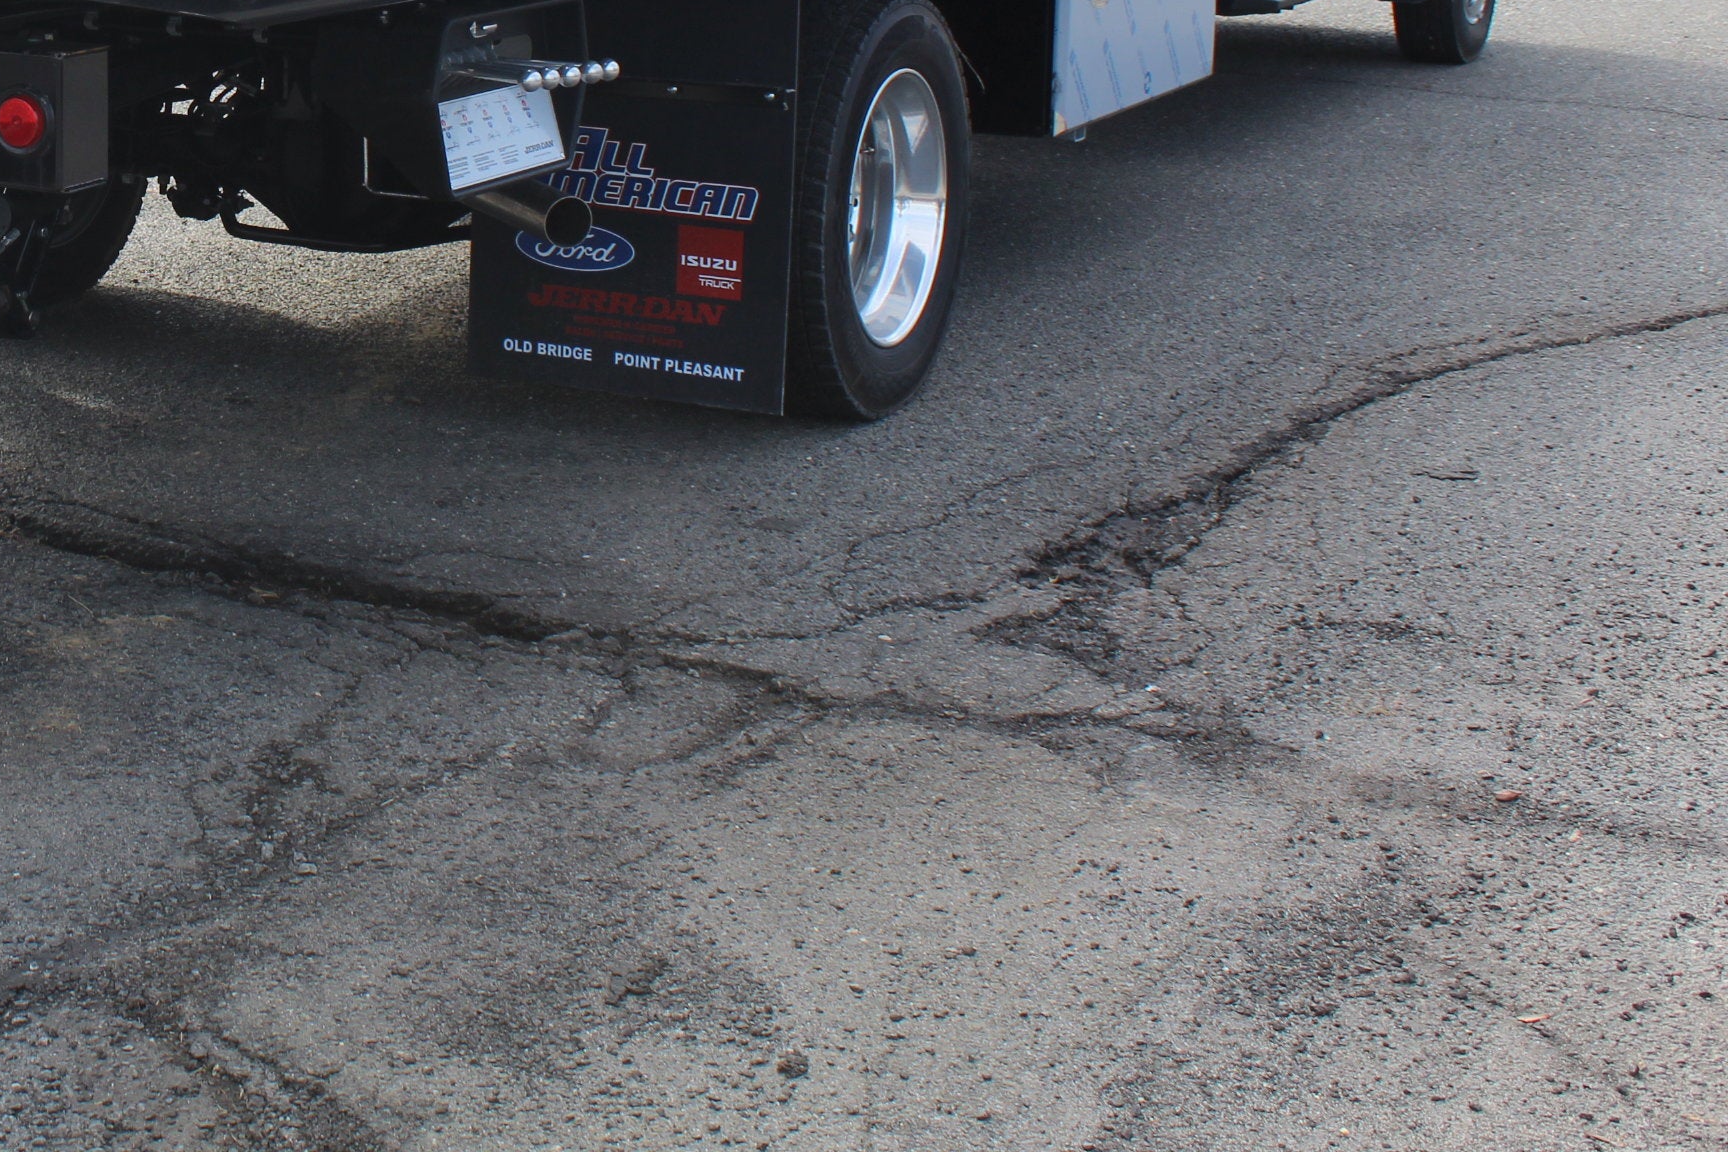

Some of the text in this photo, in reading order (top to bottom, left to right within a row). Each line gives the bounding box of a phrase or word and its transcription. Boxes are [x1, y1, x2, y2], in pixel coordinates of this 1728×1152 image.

[536, 168, 760, 222] MERICAN
[680, 254, 738, 272] ISUZU
[699, 278, 736, 291] TRUCK
[527, 284, 728, 327] JERR-DAN
[502, 338, 745, 383] OLD BRIDGE POINT PLEASANT
